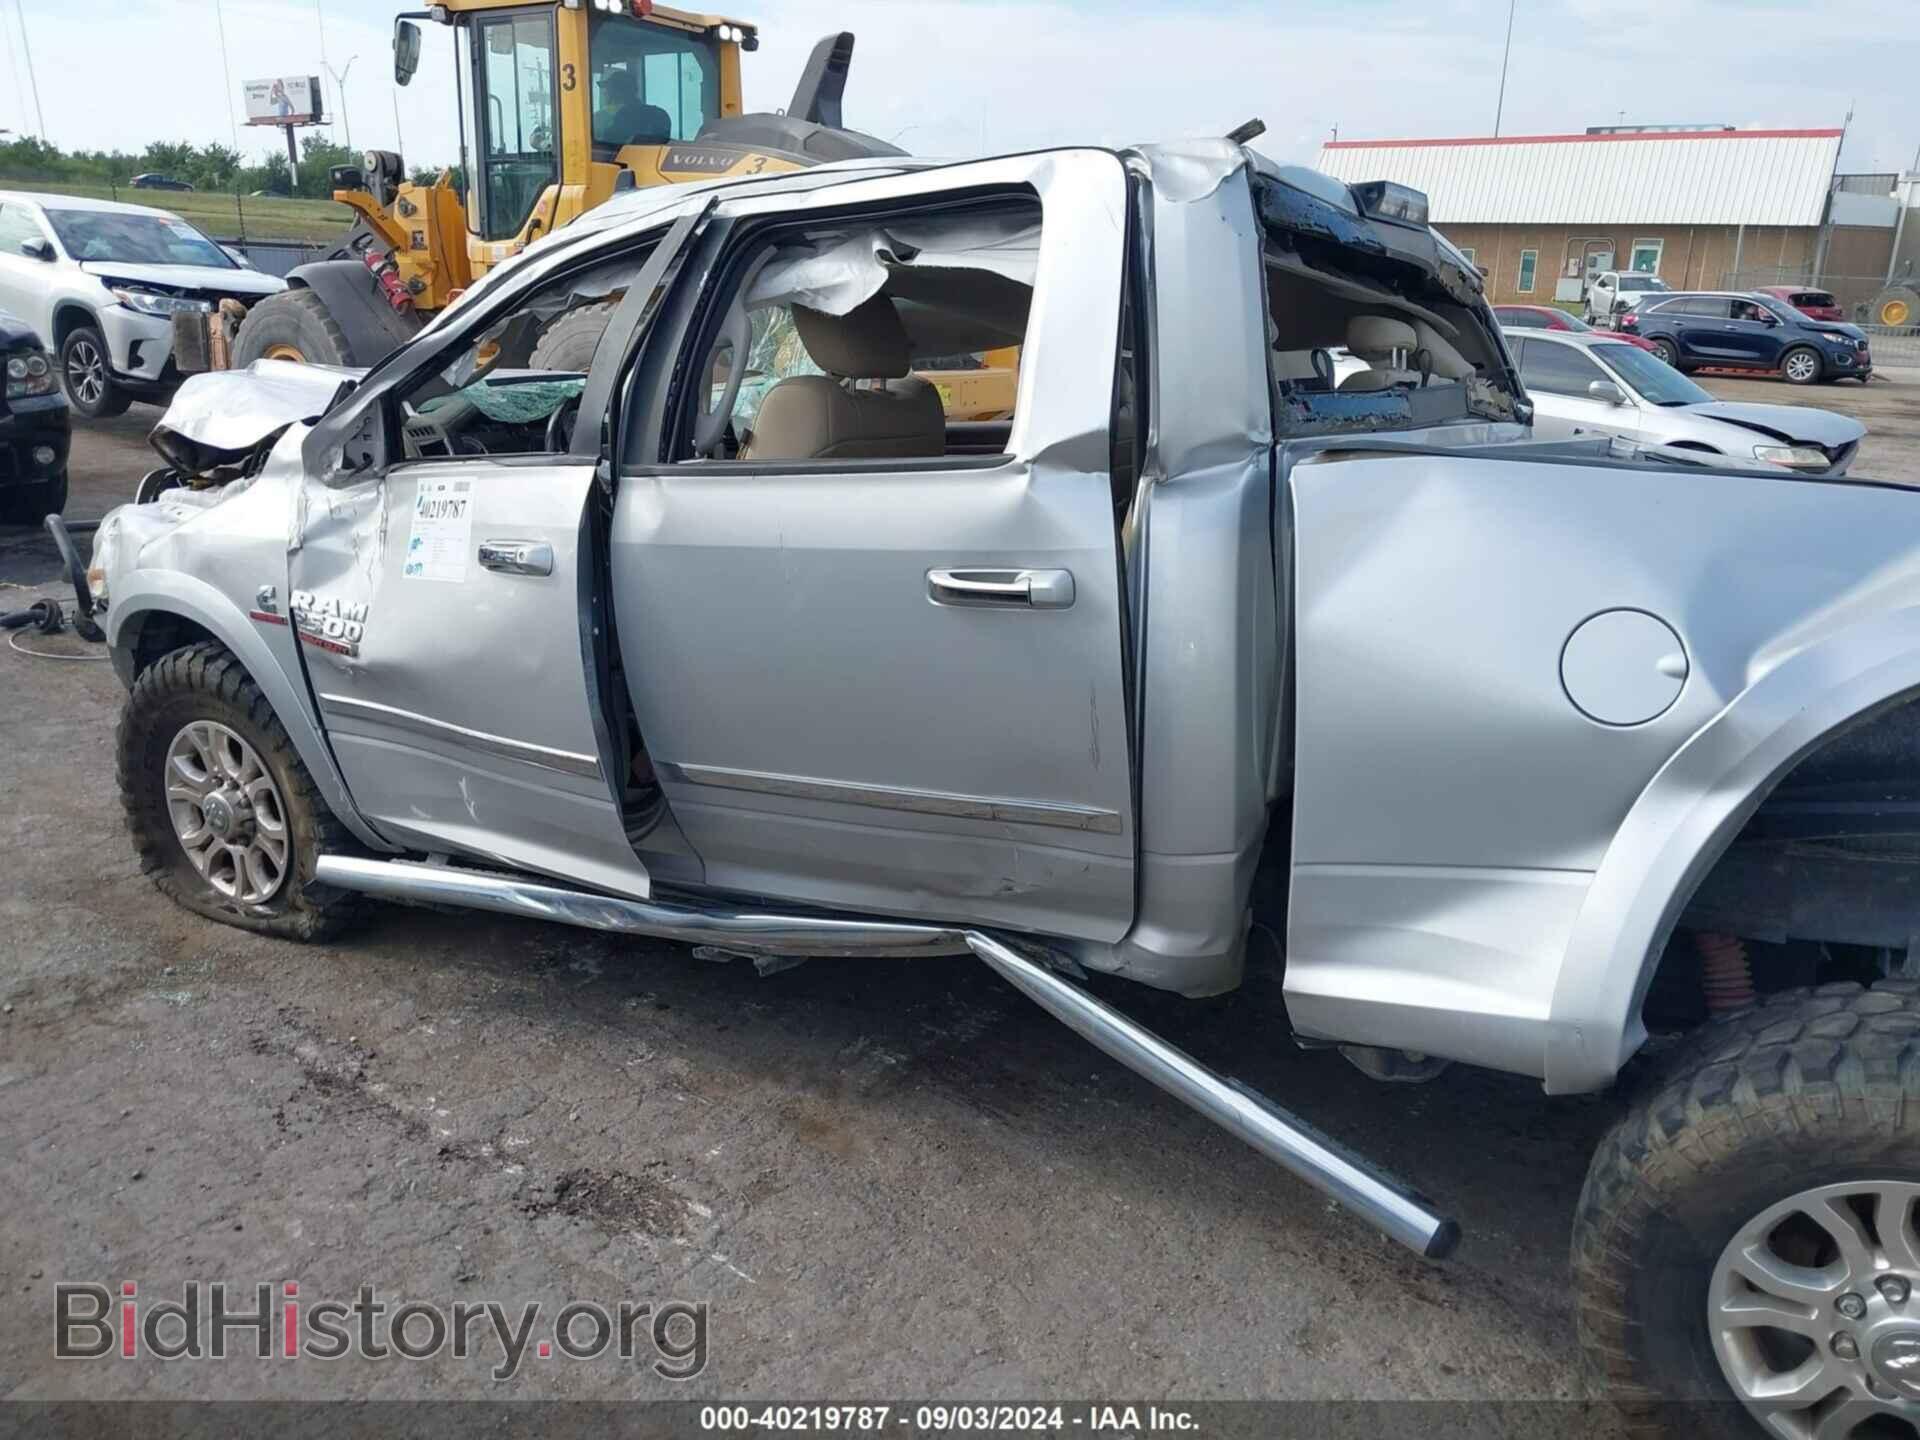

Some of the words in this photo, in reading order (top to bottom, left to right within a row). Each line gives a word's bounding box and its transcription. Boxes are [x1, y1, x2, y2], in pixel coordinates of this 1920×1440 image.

[562, 63, 577, 91] 3
[671, 153, 735, 166] VOLVO
[746, 156, 769, 176] 3
[289, 589, 369, 624] RAM
